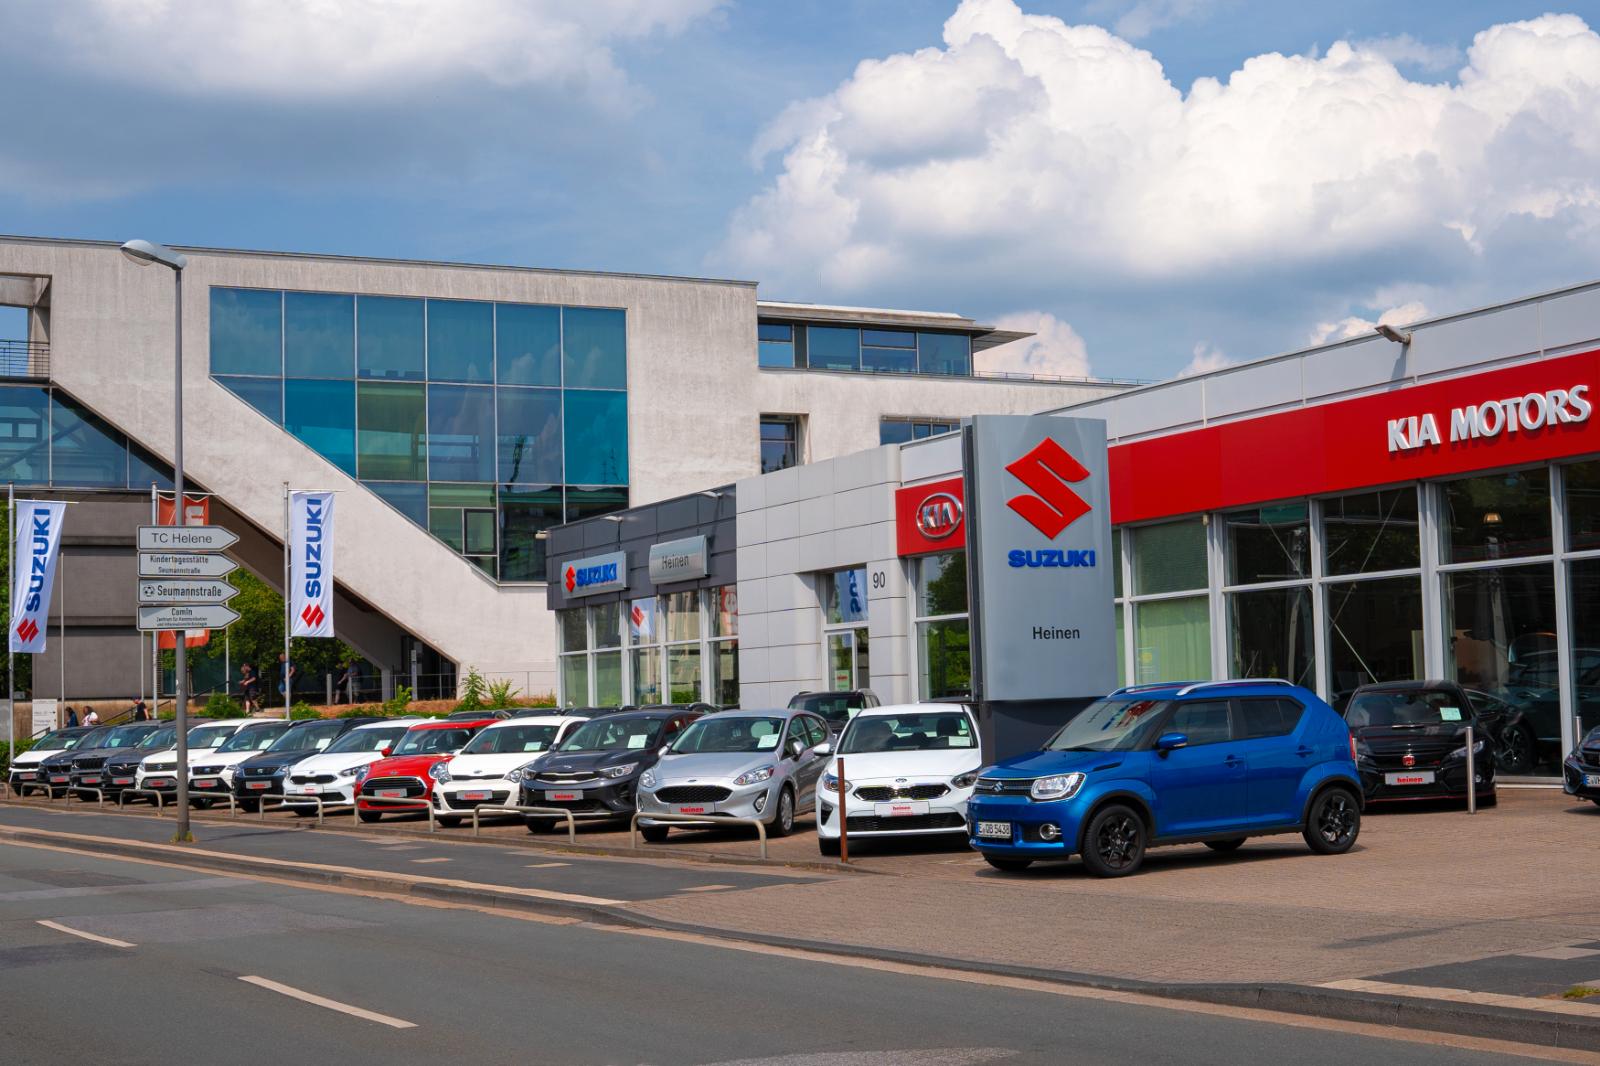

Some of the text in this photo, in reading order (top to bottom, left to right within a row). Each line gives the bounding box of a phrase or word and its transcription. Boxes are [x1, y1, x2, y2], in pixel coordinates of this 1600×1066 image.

[1387, 384, 1592, 452] KIA MOTORS
[922, 503, 956, 529] KIA
[151, 533, 213, 543] TC Helene
[305, 498, 322, 598] SUZUKI
[26, 508, 51, 612] SUZUKI
[661, 553, 689, 570] Heinen
[1007, 549, 1096, 568] SUZUKI
[576, 562, 617, 587] SUZUKI
[872, 571, 886, 589] 90
[157, 585, 222, 597] Seumannstraße
[1032, 626, 1081, 640] Heinen
